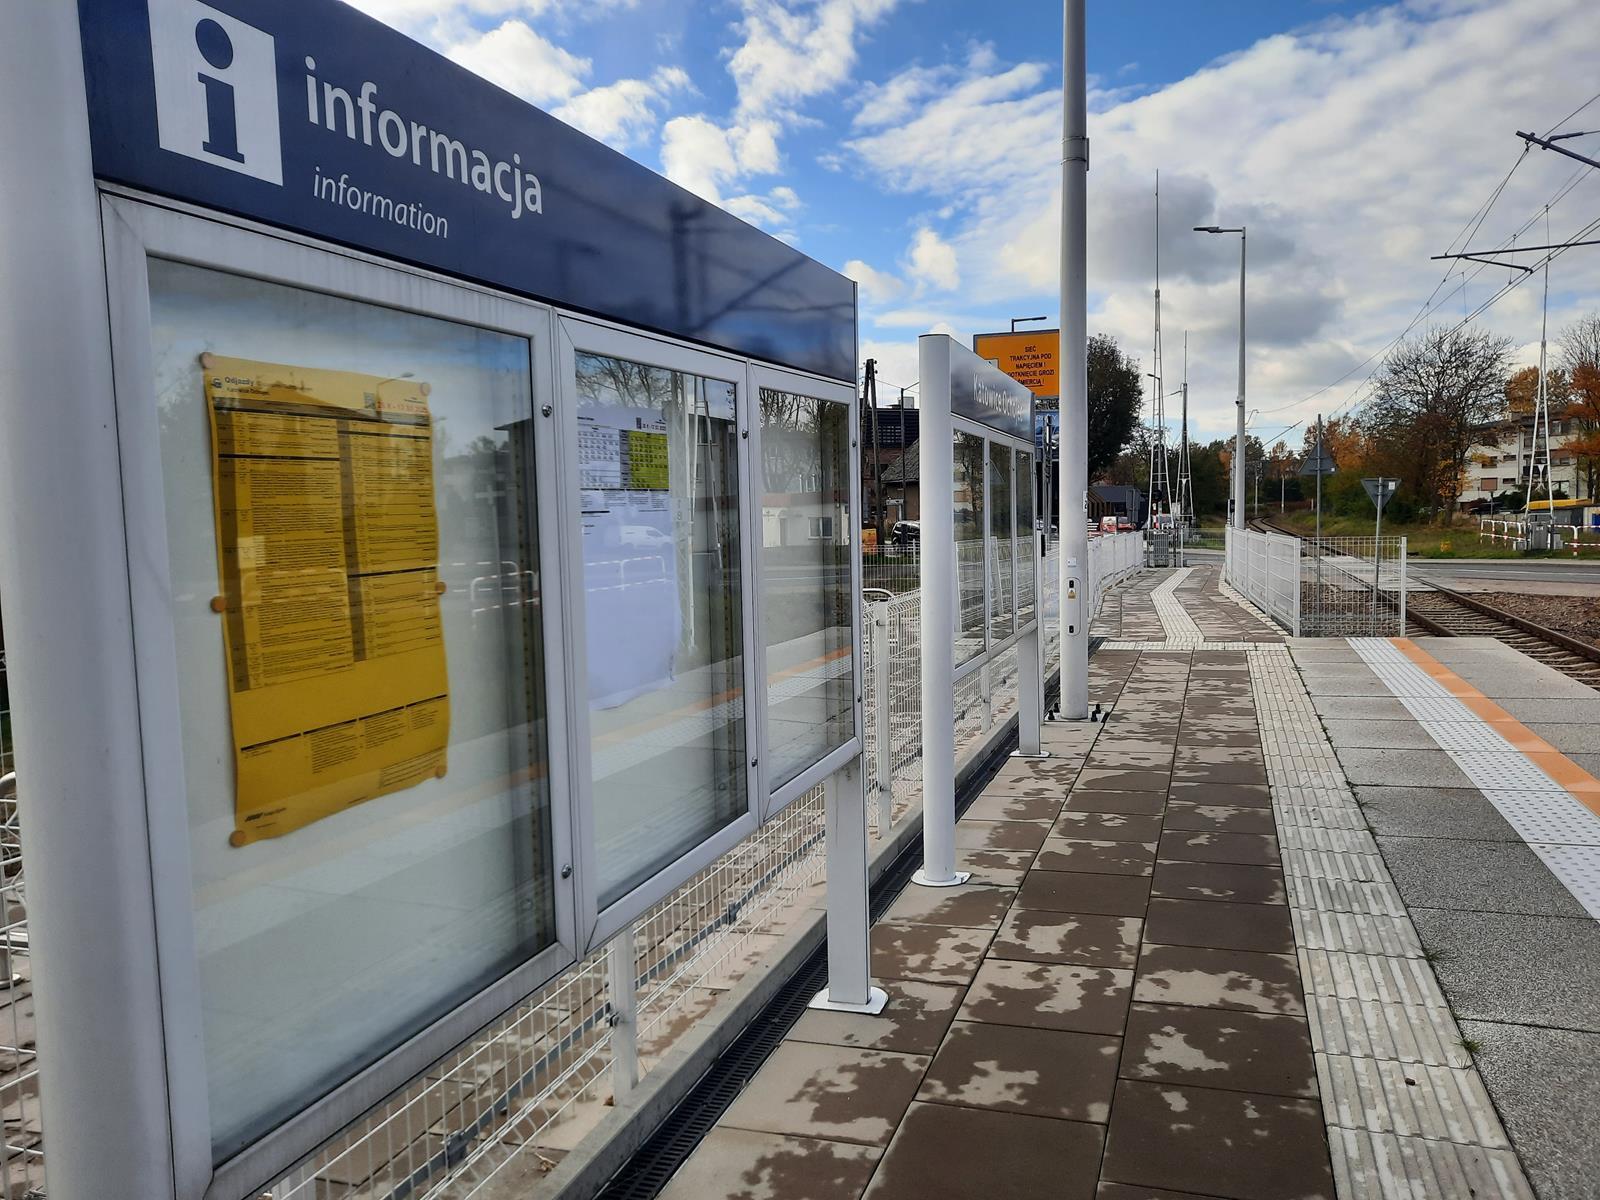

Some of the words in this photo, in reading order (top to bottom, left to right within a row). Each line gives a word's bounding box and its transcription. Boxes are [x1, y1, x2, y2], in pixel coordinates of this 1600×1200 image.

[304, 55, 543, 219] informacja
[312, 166, 449, 239] information
[973, 372, 1001, 412] Katowice
